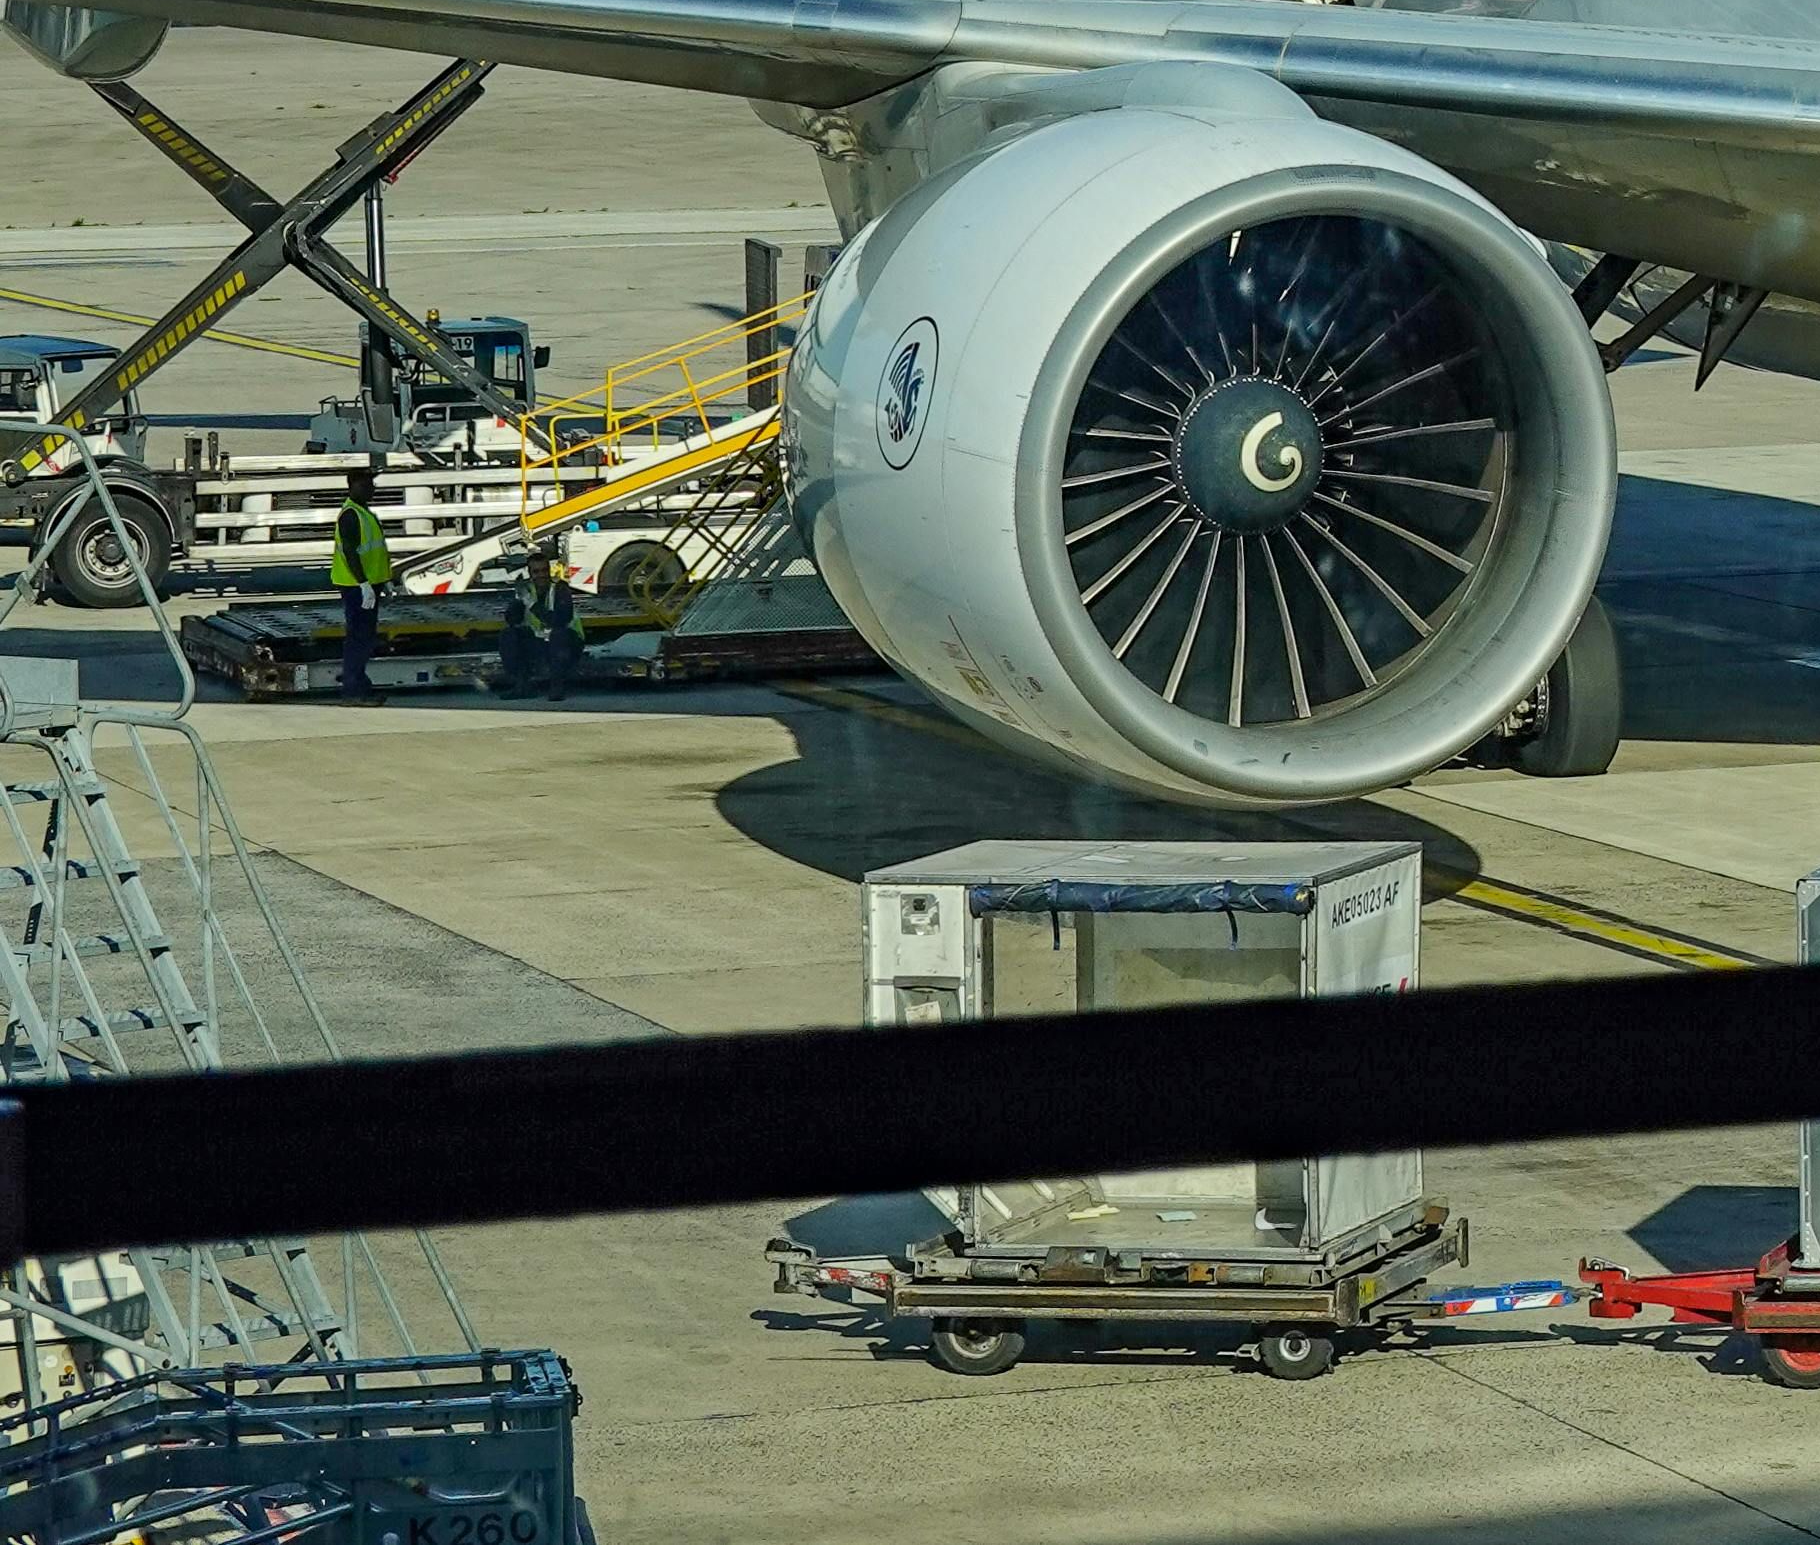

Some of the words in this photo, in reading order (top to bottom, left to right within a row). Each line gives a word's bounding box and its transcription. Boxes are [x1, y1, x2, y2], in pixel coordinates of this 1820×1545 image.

[1331, 887, 1382, 929] AKE05023
[1383, 880, 1400, 909] AF
[409, 1515, 438, 1545] K
[450, 1510, 538, 1545] 260
